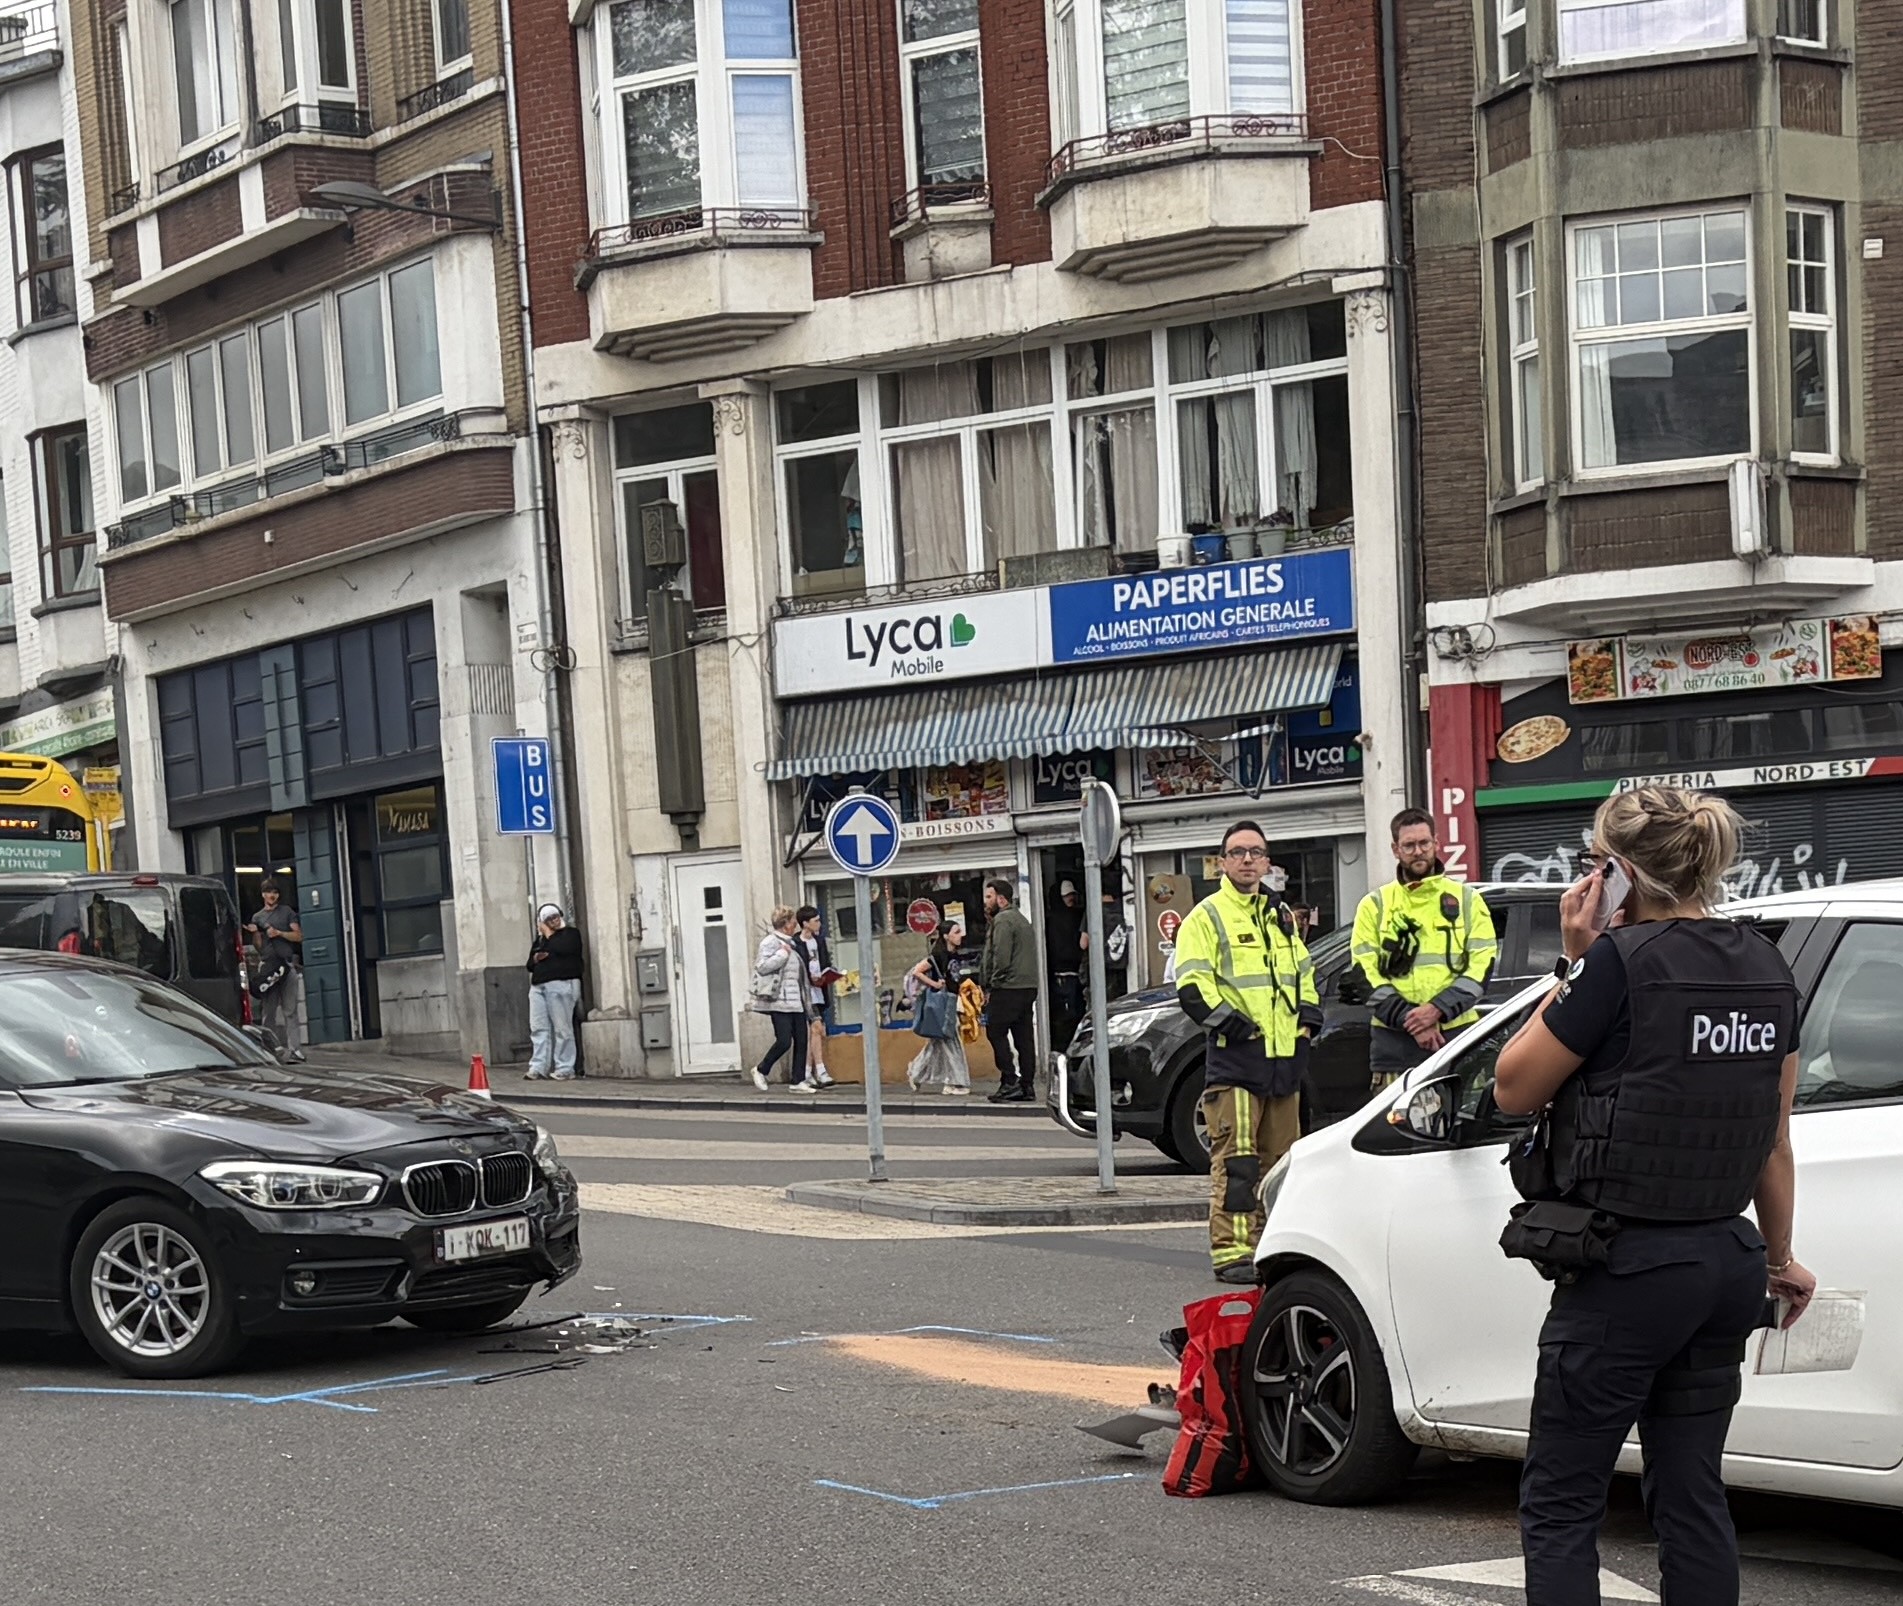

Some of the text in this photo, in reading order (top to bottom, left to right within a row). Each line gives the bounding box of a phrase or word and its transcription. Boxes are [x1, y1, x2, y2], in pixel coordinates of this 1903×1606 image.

[1113, 563, 1285, 613] PAPERFLIES
[1086, 598, 1315, 643] ALIMENTATION GENERALE
[845, 615, 943, 668] Lyca
[1072, 644, 1105, 656] ALCOOL
[1110, 639, 1149, 652] BOISSONS
[1235, 625, 1265, 637] CARTES
[890, 655, 945, 679] Mobile
[1334, 675, 1352, 689] orld
[1037, 757, 1091, 787] Lyca
[1293, 745, 1345, 772] Lyca
[1753, 760, 1868, 783] NORD-EST
[526, 744, 547, 828] BUS
[55, 829, 82, 841] 5239
[23, 860, 49, 870] VILLE
[1692, 1011, 1776, 1054] Police
